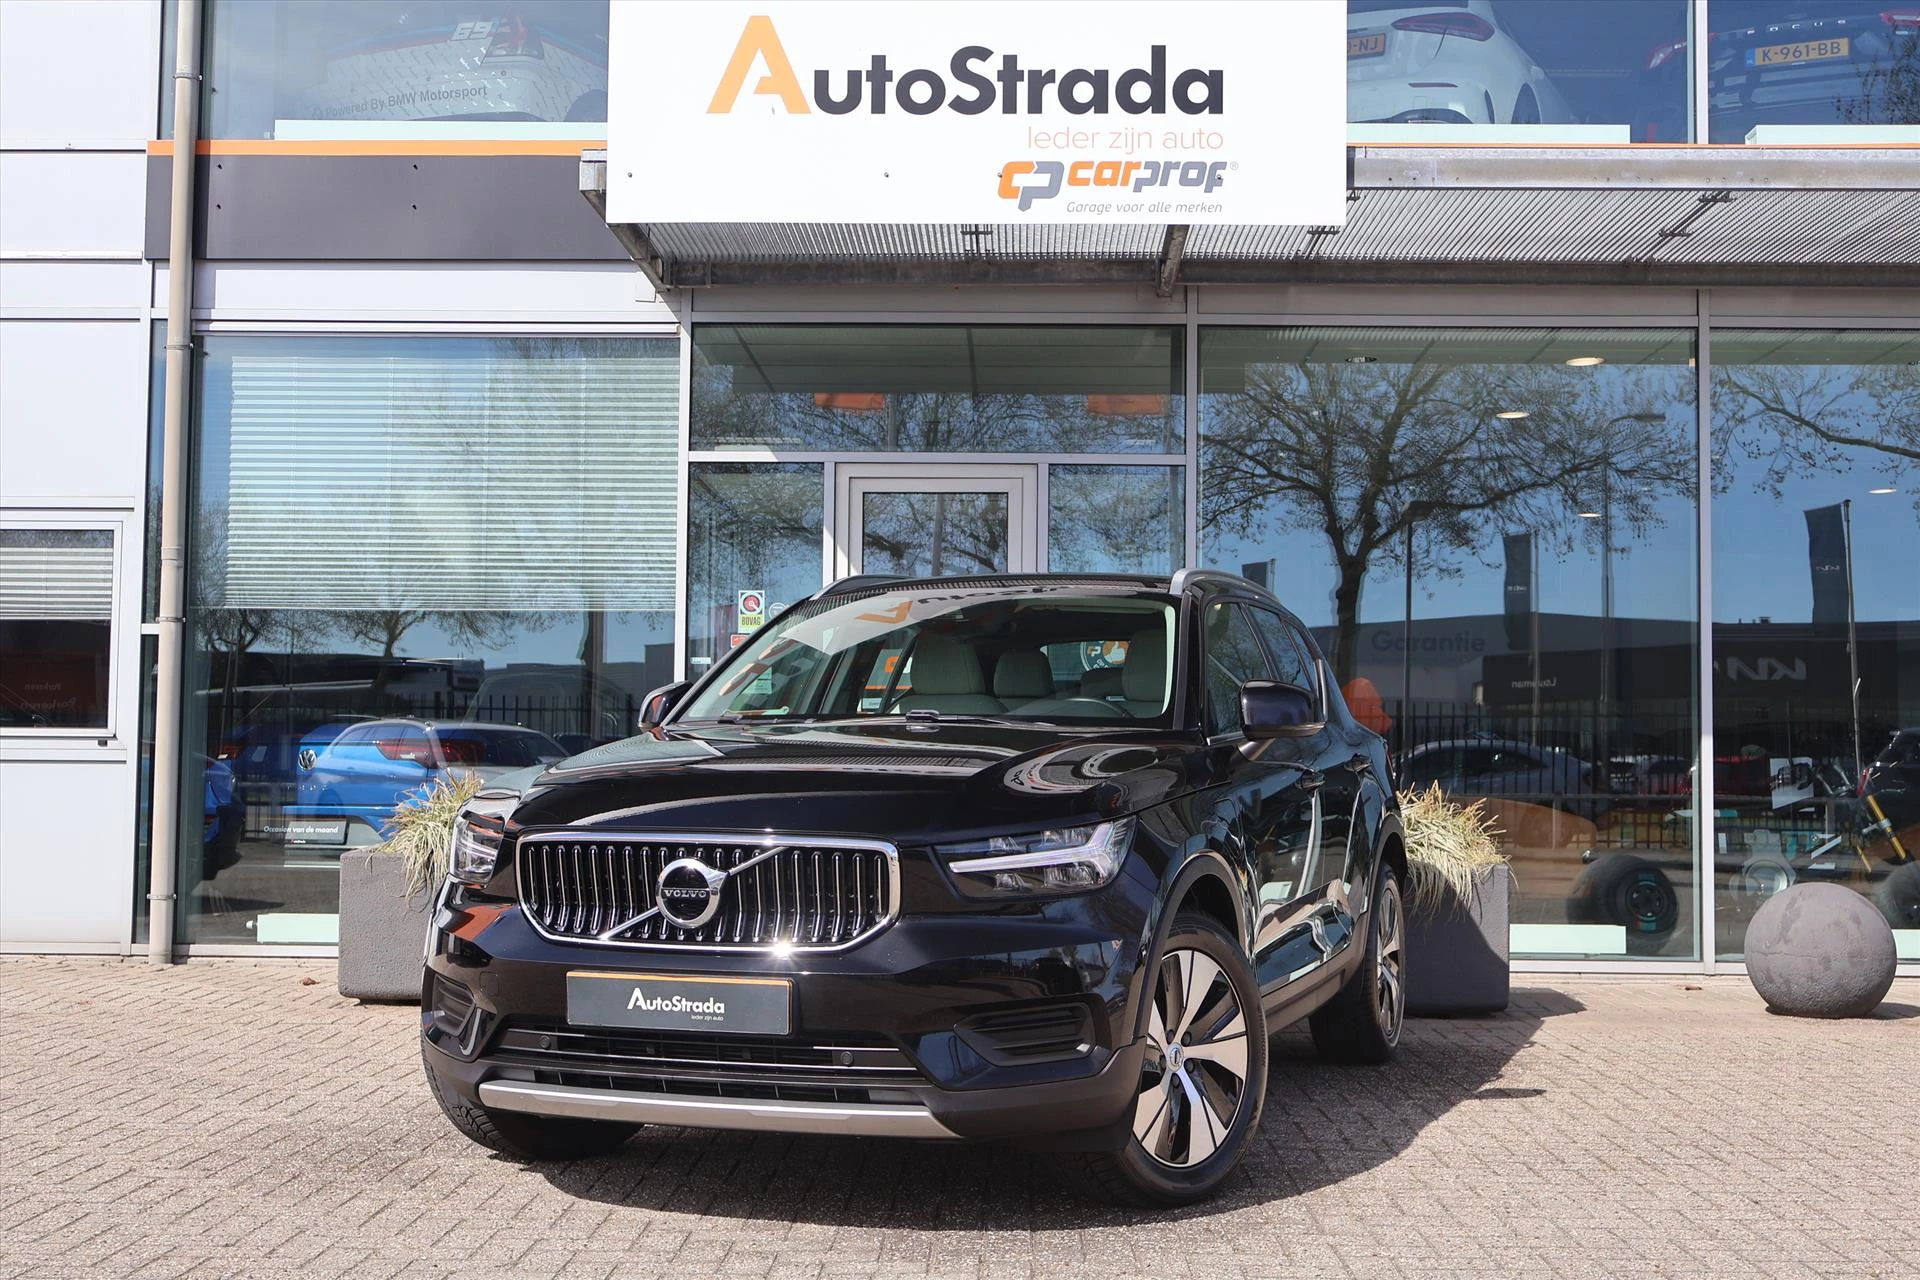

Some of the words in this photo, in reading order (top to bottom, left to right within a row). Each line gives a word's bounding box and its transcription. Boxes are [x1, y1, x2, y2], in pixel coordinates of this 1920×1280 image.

[452, 21, 493, 41] 69
[1762, 41, 1842, 62] K-961-BB
[705, 15, 1225, 115] AutoStrada
[325, 102, 369, 118] Powered
[370, 98, 385, 112] By
[387, 92, 418, 108] BMW
[420, 85, 488, 102] Motorsport
[1028, 126, 1101, 149] Ieder
[1109, 127, 1153, 155] zijn
[1162, 128, 1225, 150] auto
[1066, 201, 1112, 215] Garage
[1116, 204, 1145, 213] voor
[1148, 201, 1171, 213] alle
[1175, 201, 1223, 213] merken
[741, 616, 761, 625] BOVAG
[1371, 630, 1486, 652] Garantie
[263, 825, 291, 833] Occasion
[664, 889, 707, 898] VOLVO
[627, 987, 725, 1014] AutoStrada
